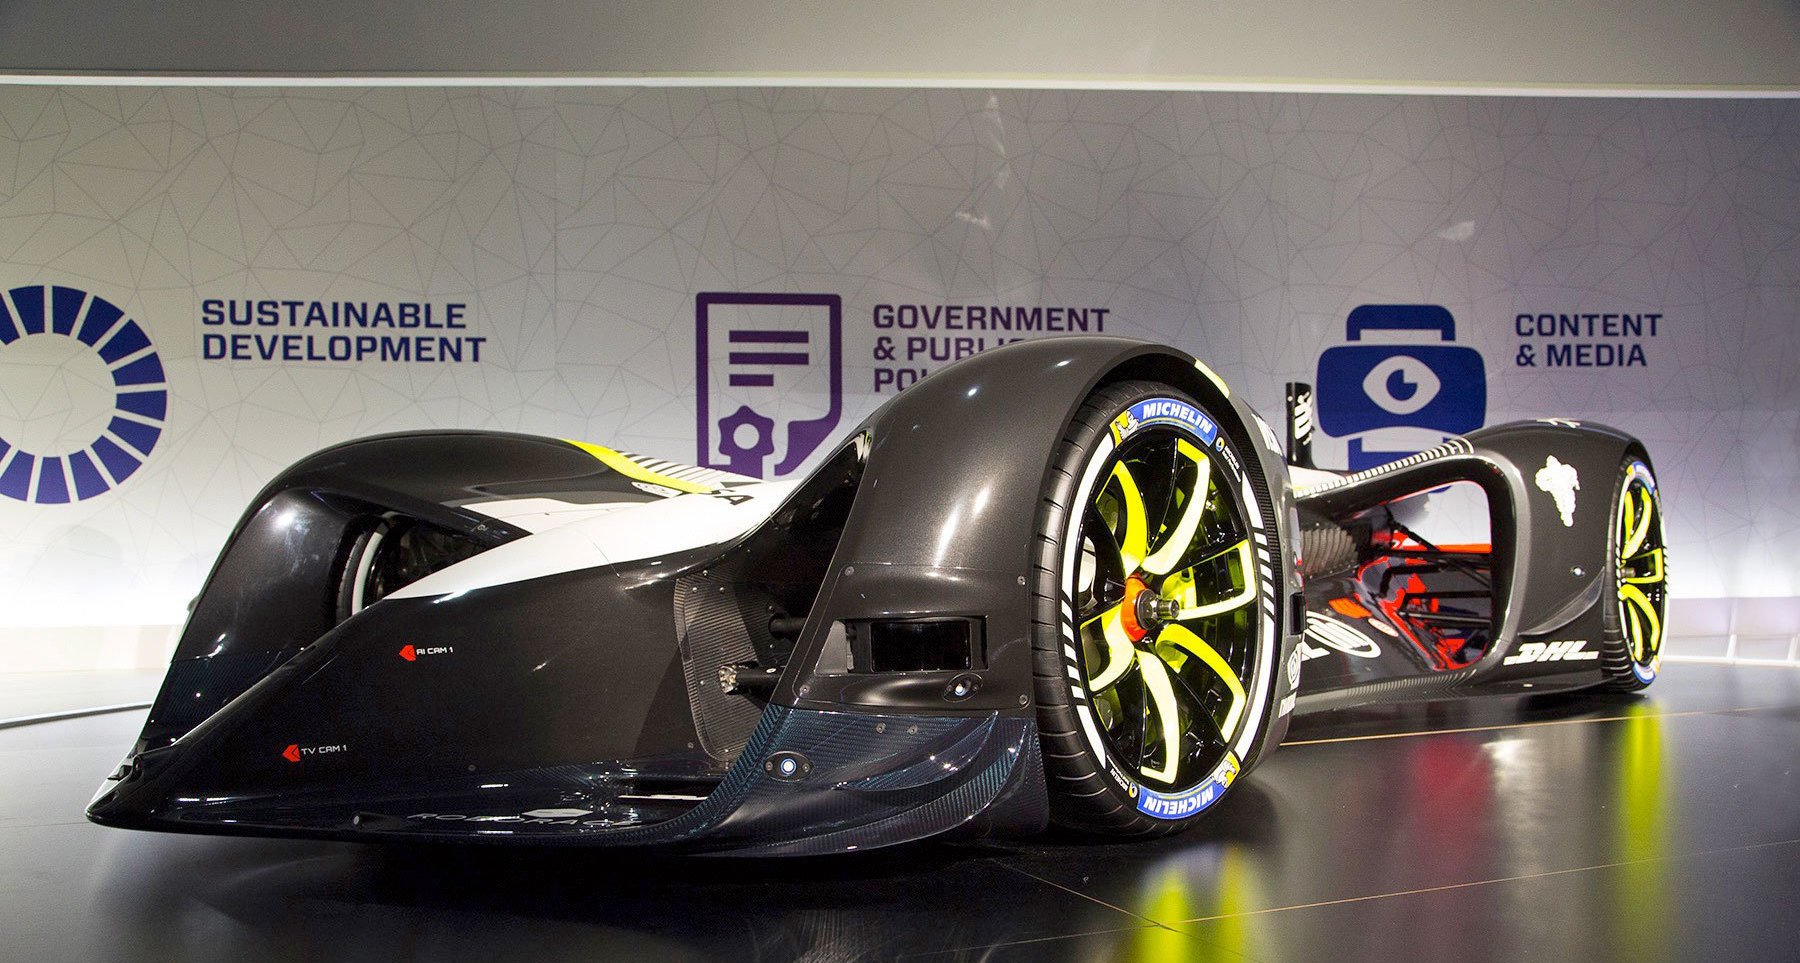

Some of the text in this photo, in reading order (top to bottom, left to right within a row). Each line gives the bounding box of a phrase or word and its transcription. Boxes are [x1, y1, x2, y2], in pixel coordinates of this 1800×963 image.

[202, 299, 467, 329] SUSTAINABLE
[873, 304, 1110, 332] GOVERNMENT
[1515, 313, 1663, 337] CONTENT
[202, 333, 487, 362] DEVELOPMENT
[873, 336, 896, 361] &
[1516, 344, 1647, 367] & MEDIA
[1142, 402, 1213, 434] MICHELIN
[427, 647, 448, 655] CAM
[1510, 640, 1595, 665] DHL
[318, 745, 341, 754] CAM
[1143, 784, 1214, 815] MICHELIN
